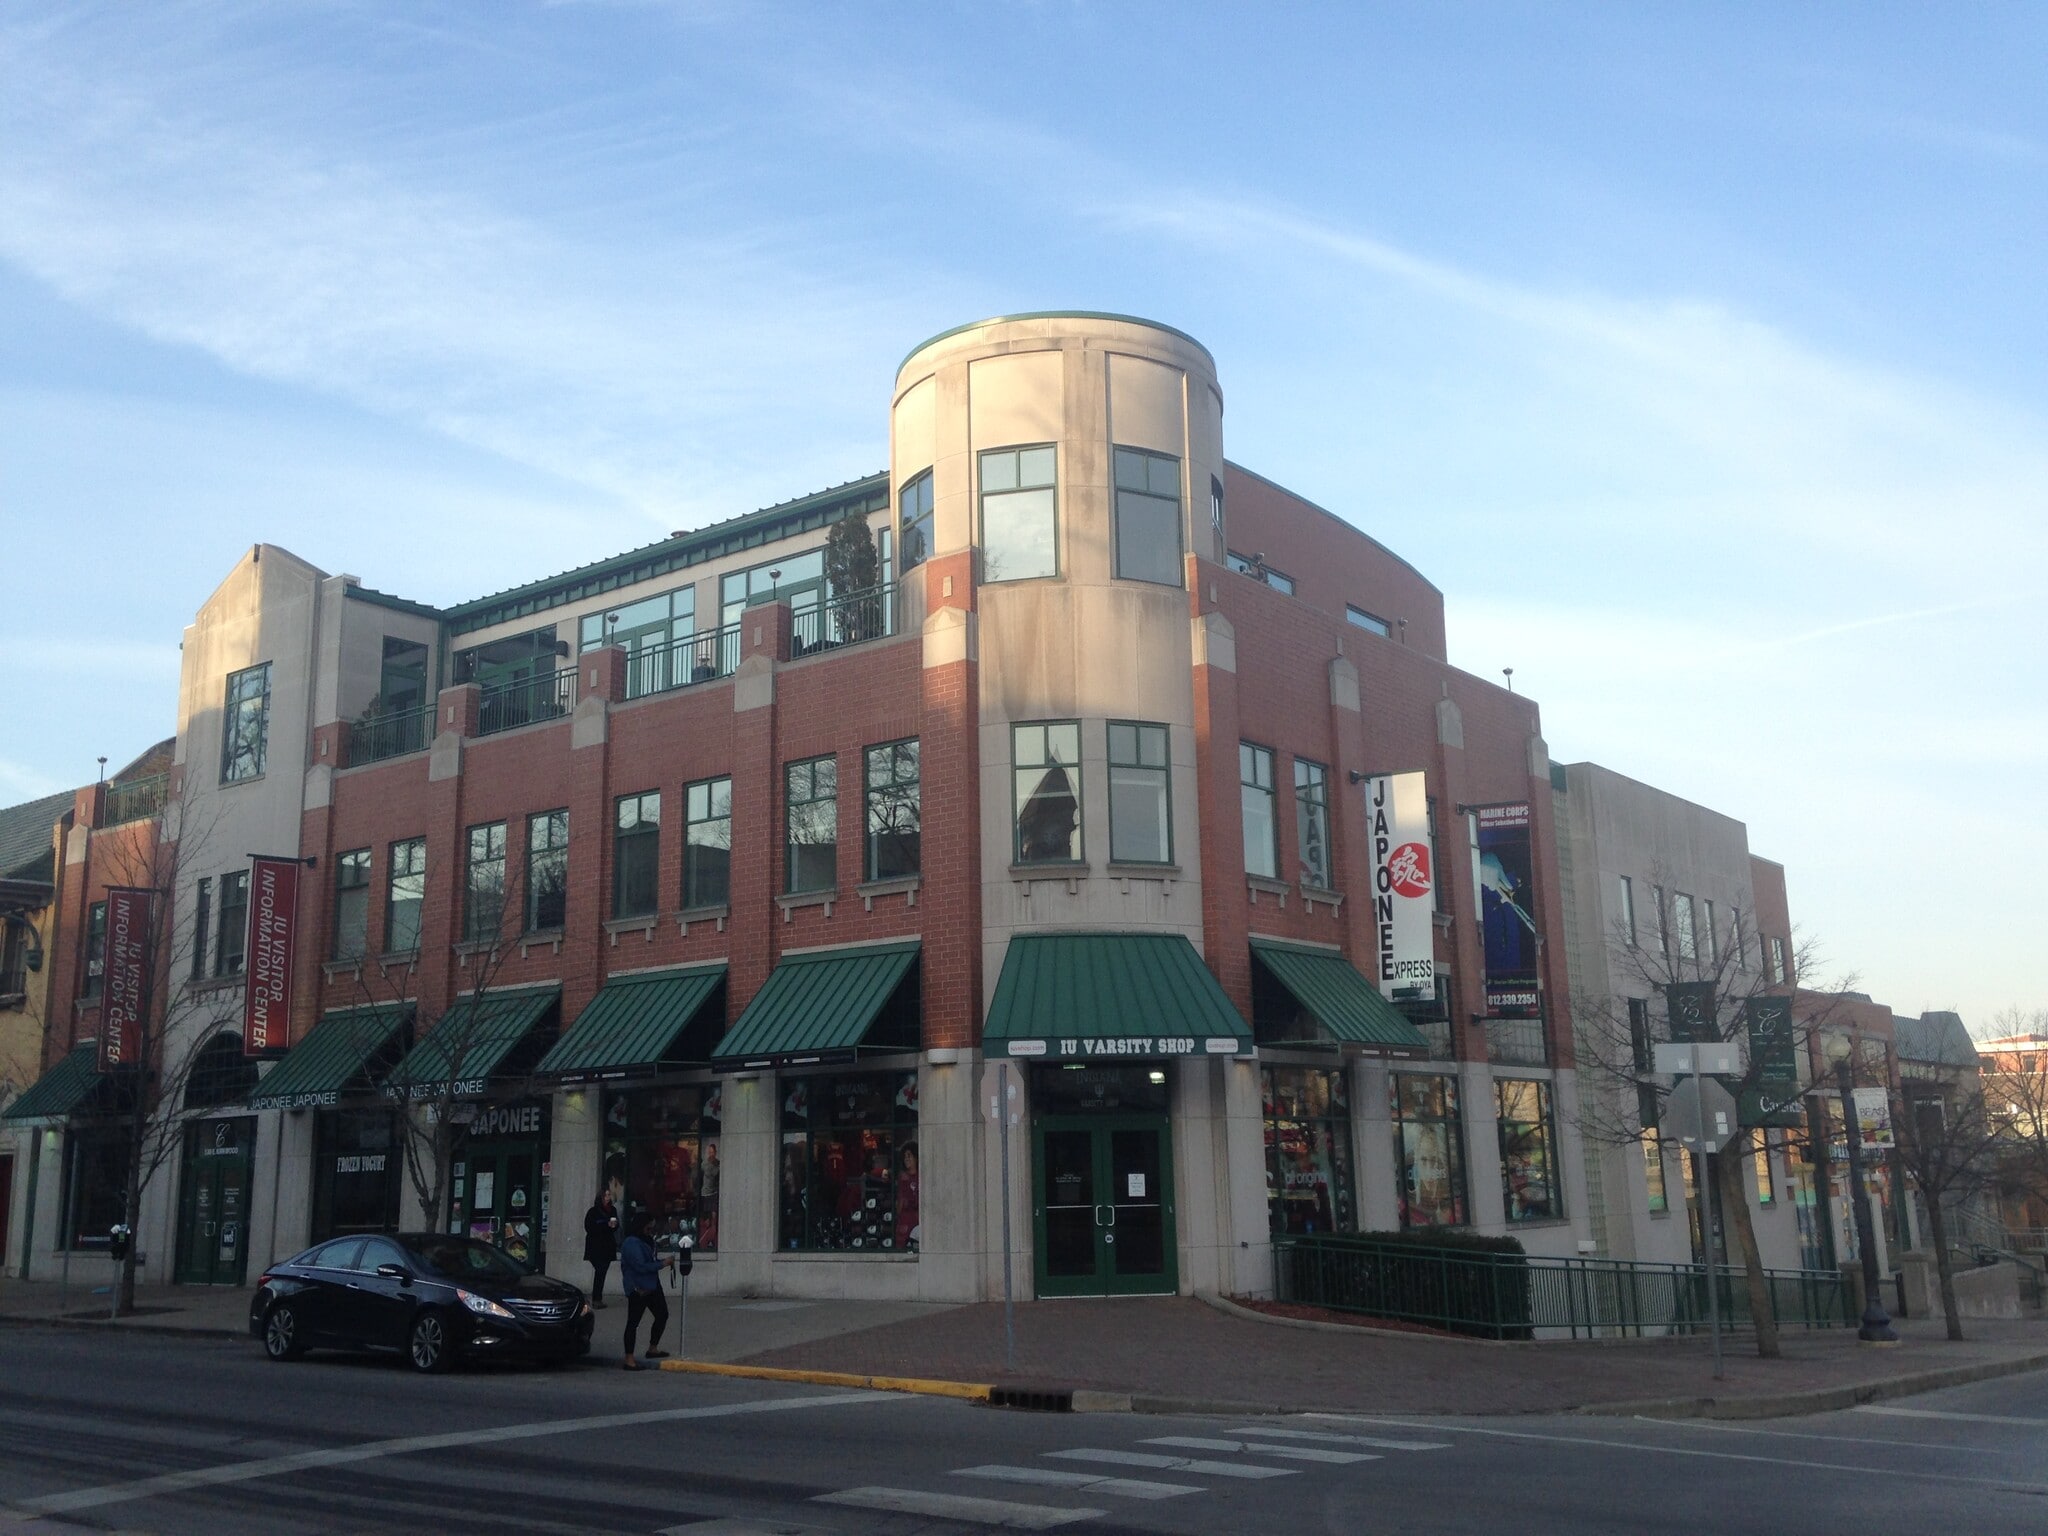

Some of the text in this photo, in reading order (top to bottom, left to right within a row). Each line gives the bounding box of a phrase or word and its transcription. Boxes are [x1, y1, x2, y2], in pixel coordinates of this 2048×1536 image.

[1480, 806, 1529, 819] MARINE CORPS
[1374, 780, 1394, 981] JAPONEE
[252, 868, 275, 1049] INFORMATION CENTER
[270, 915, 287, 1003] IU VISITOR
[107, 898, 130, 1065] INFORMATION CENTER
[1060, 1038, 1195, 1055] IU VARSITY SHOP
[250, 1091, 337, 1111] JAPONEE JAPONEE
[470, 1106, 541, 1137] JAPONEE
[337, 1155, 386, 1173] FROZEN YOGURT
